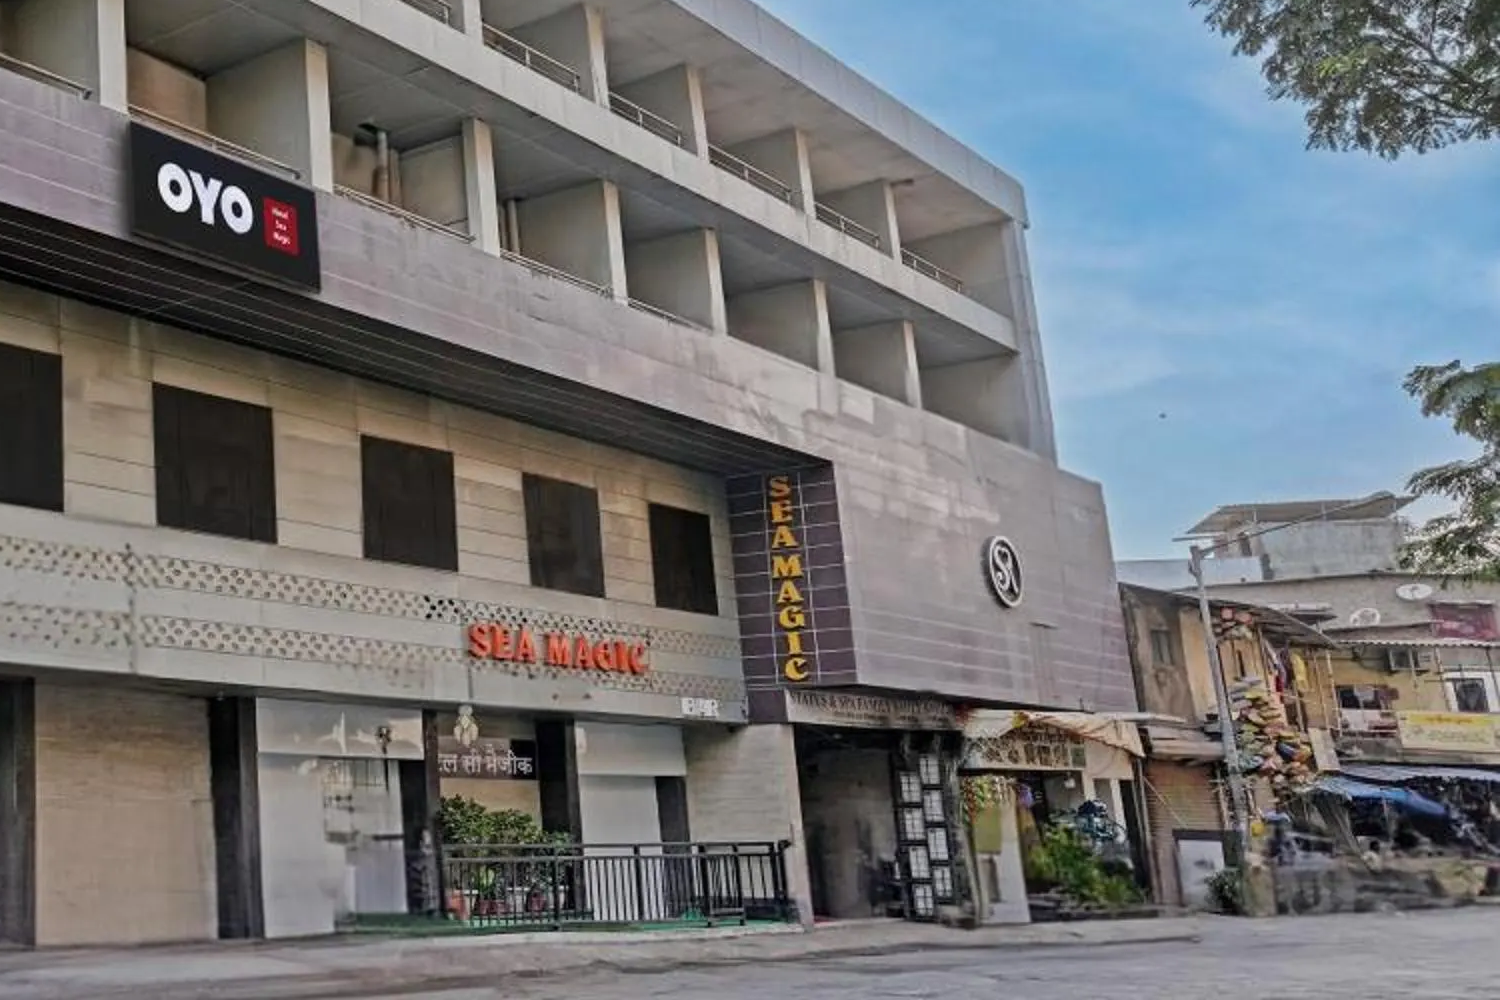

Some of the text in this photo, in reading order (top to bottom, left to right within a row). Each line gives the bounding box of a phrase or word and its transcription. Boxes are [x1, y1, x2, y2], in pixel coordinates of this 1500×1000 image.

[157, 162, 254, 235] OYO
[769, 476, 809, 681] SEA MAGIC
[468, 621, 649, 675] SEA MAGIC
